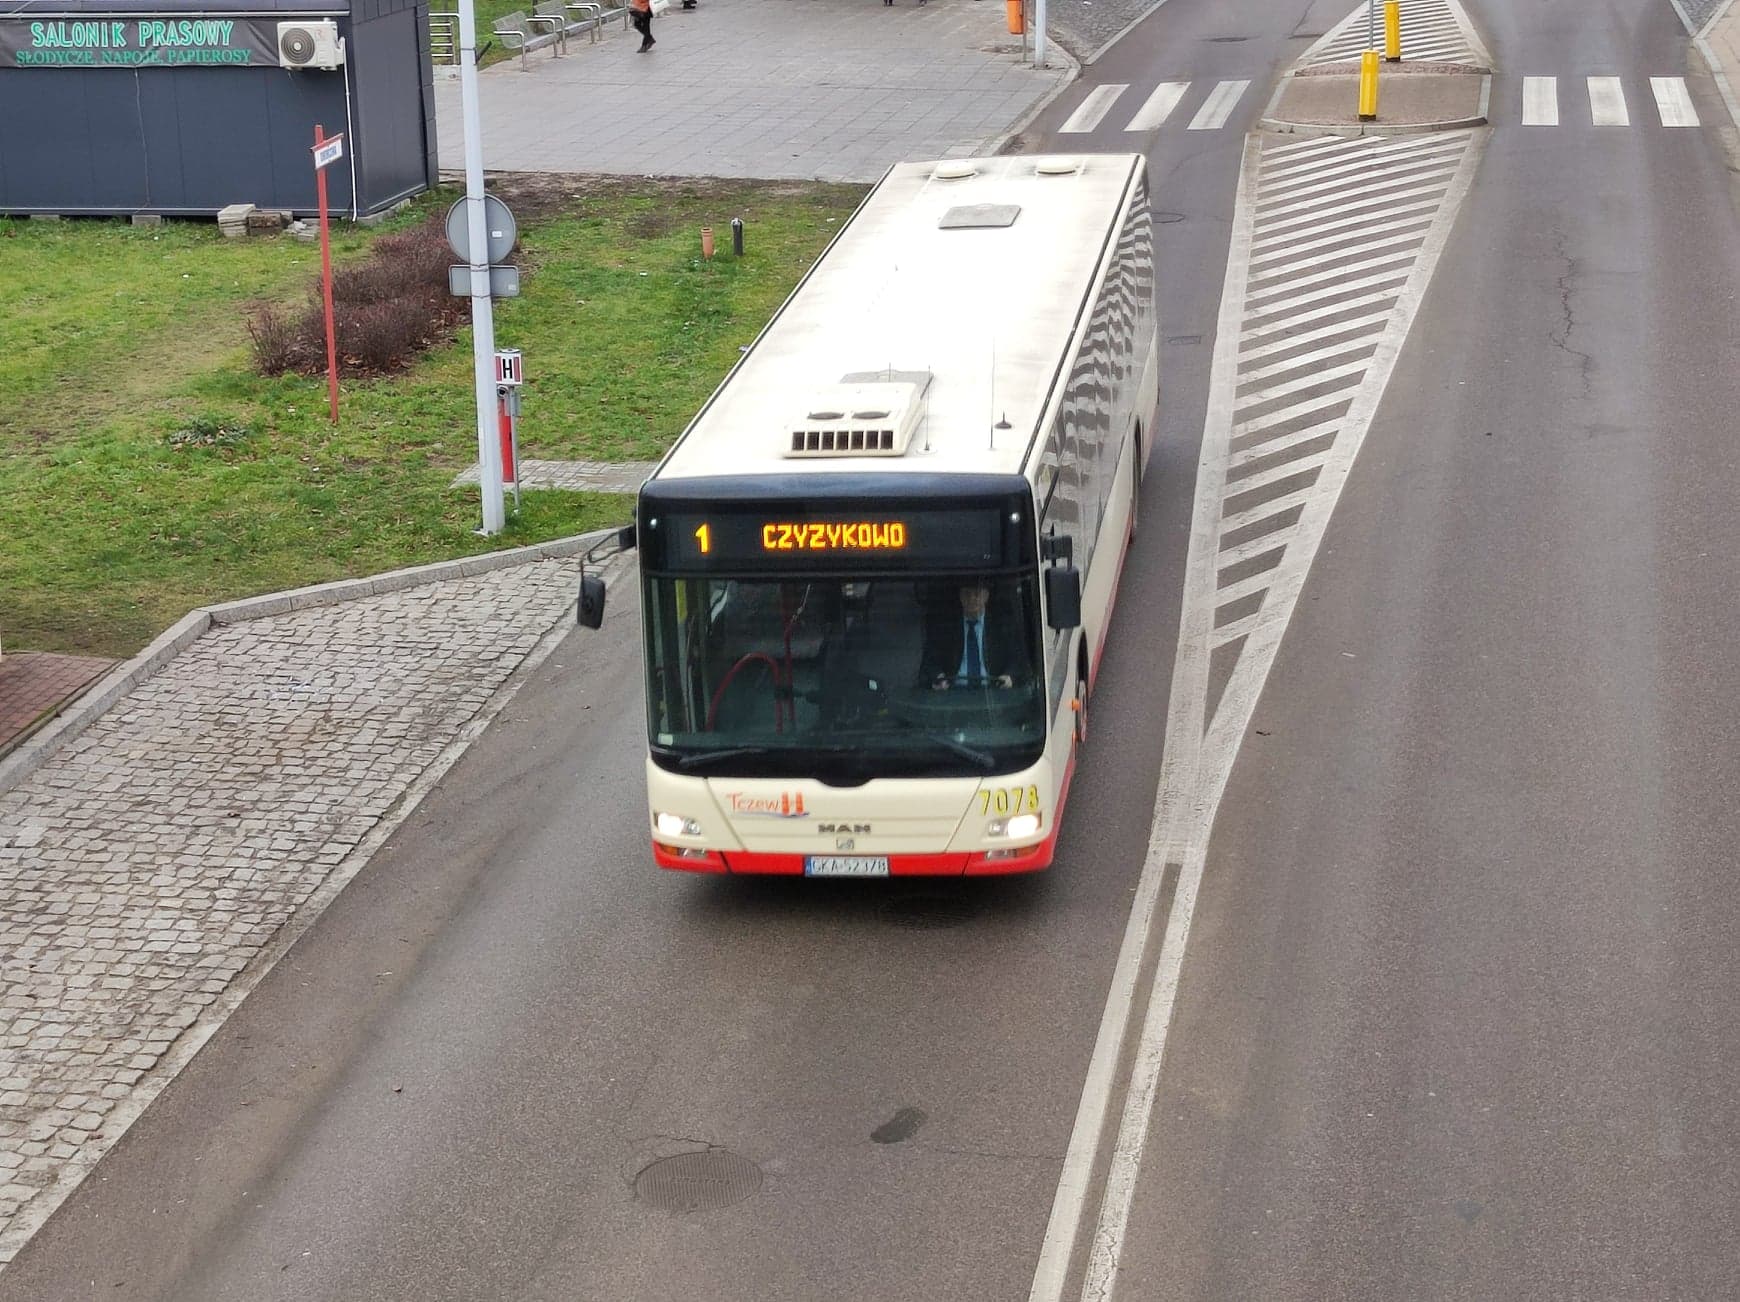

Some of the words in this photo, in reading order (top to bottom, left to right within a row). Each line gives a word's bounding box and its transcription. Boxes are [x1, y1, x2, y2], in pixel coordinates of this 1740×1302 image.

[31, 22, 127, 47] SALONIK
[138, 20, 233, 47] PRASOWY
[168, 49, 250, 64] PAPIEROSY
[502, 358, 513, 379] H
[695, 523, 710, 554] 1
[762, 522, 905, 550] CZYZYKOWO
[979, 784, 1039, 816] 7078
[817, 823, 872, 834] MAN
